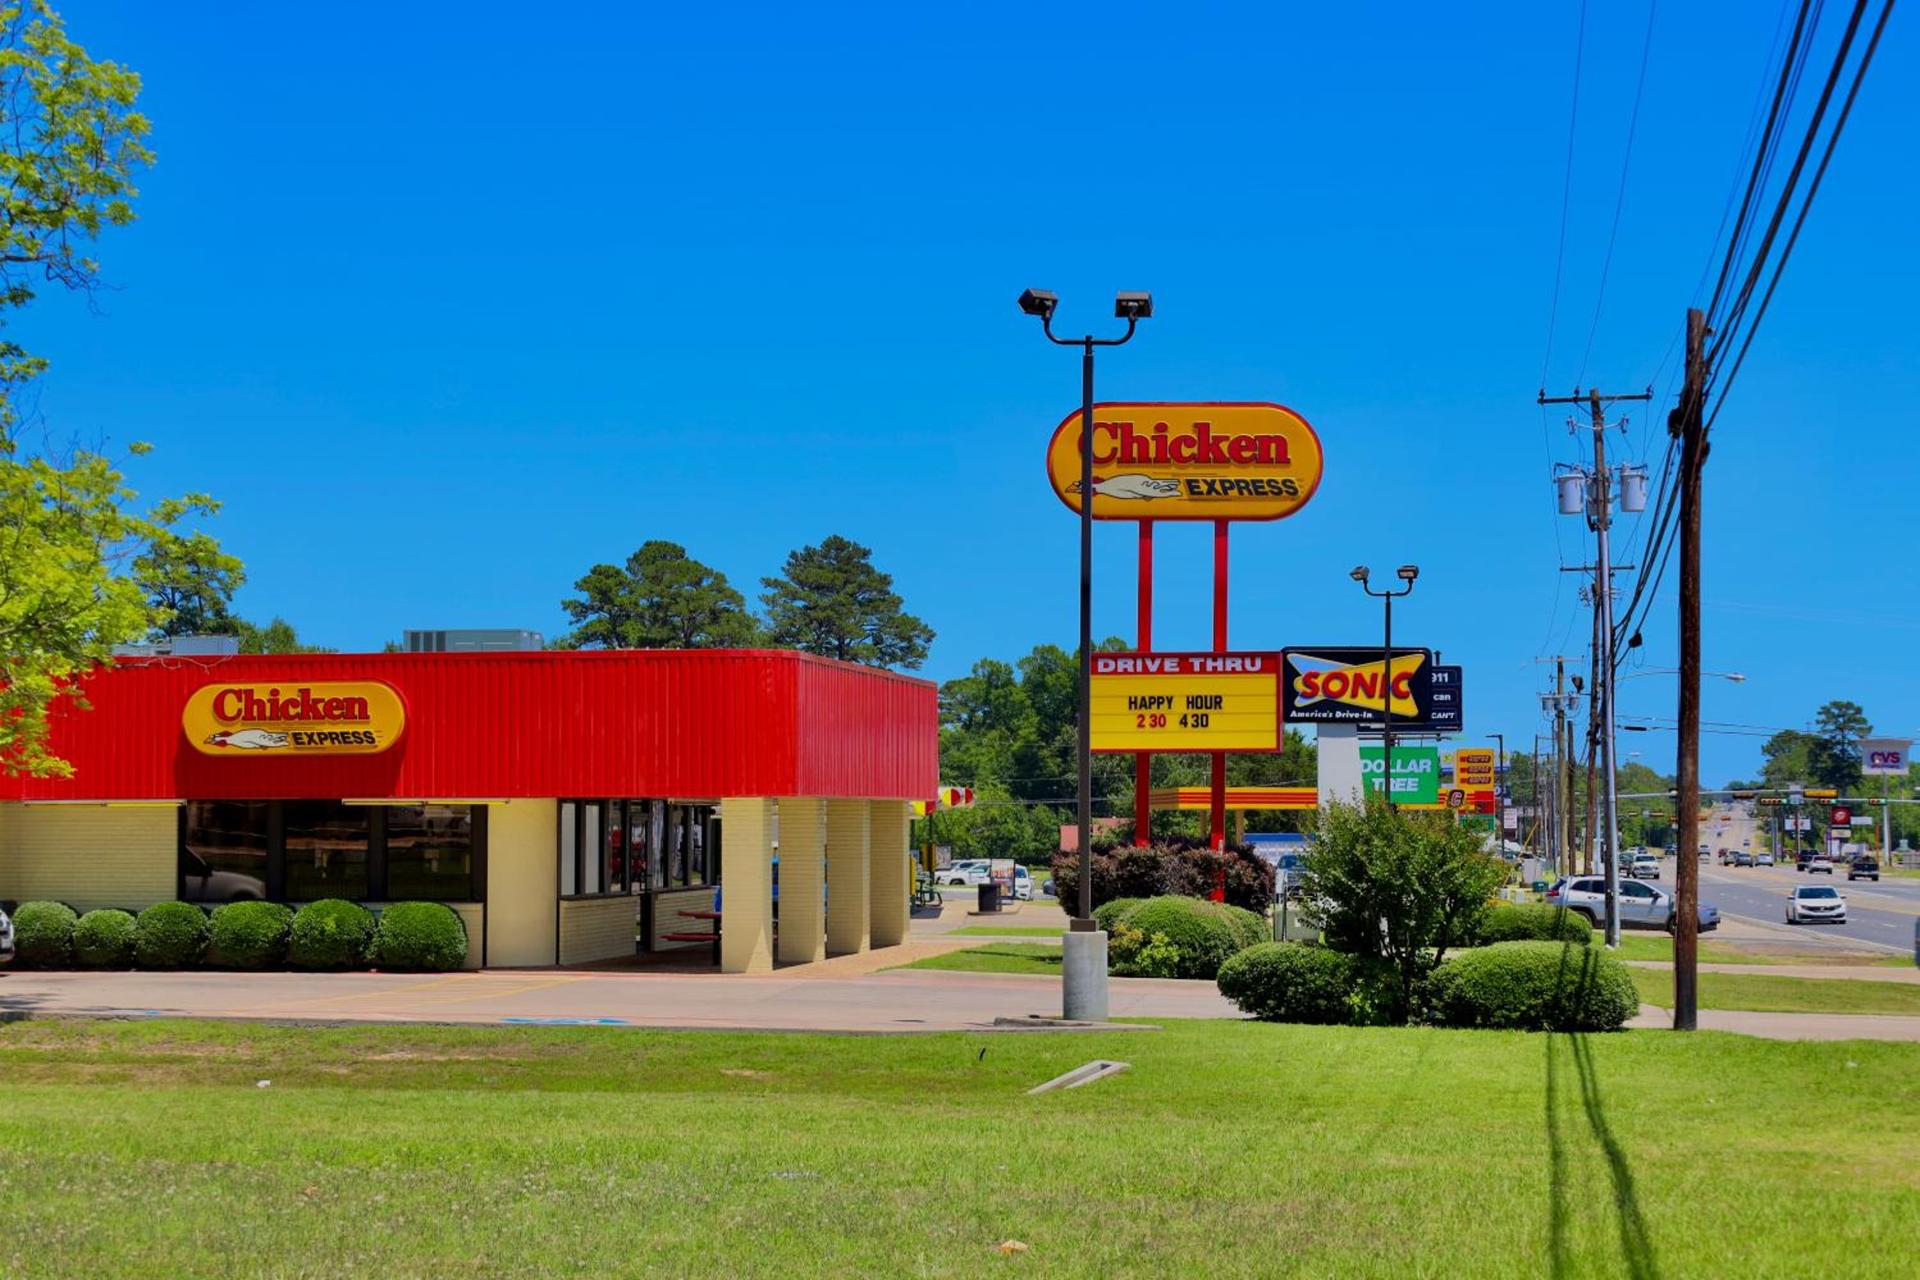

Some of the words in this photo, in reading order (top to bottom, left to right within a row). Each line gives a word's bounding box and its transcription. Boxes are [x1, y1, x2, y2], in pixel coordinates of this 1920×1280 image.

[1078, 422, 1290, 465] Chicken
[1186, 478, 1299, 497] EXPRESS
[1097, 657, 1180, 673] DRIVE
[1189, 656, 1262, 672] THRU
[1300, 671, 1413, 699] SONIC
[213, 688, 370, 722] Chicken
[1128, 695, 1174, 710] HAPPY
[1186, 695, 1223, 710] HOUR
[1290, 710, 1333, 718] America's
[1335, 710, 1373, 719] Drive-In
[292, 731, 376, 746] EXPRESS
[1372, 778, 1419, 792] TREE
